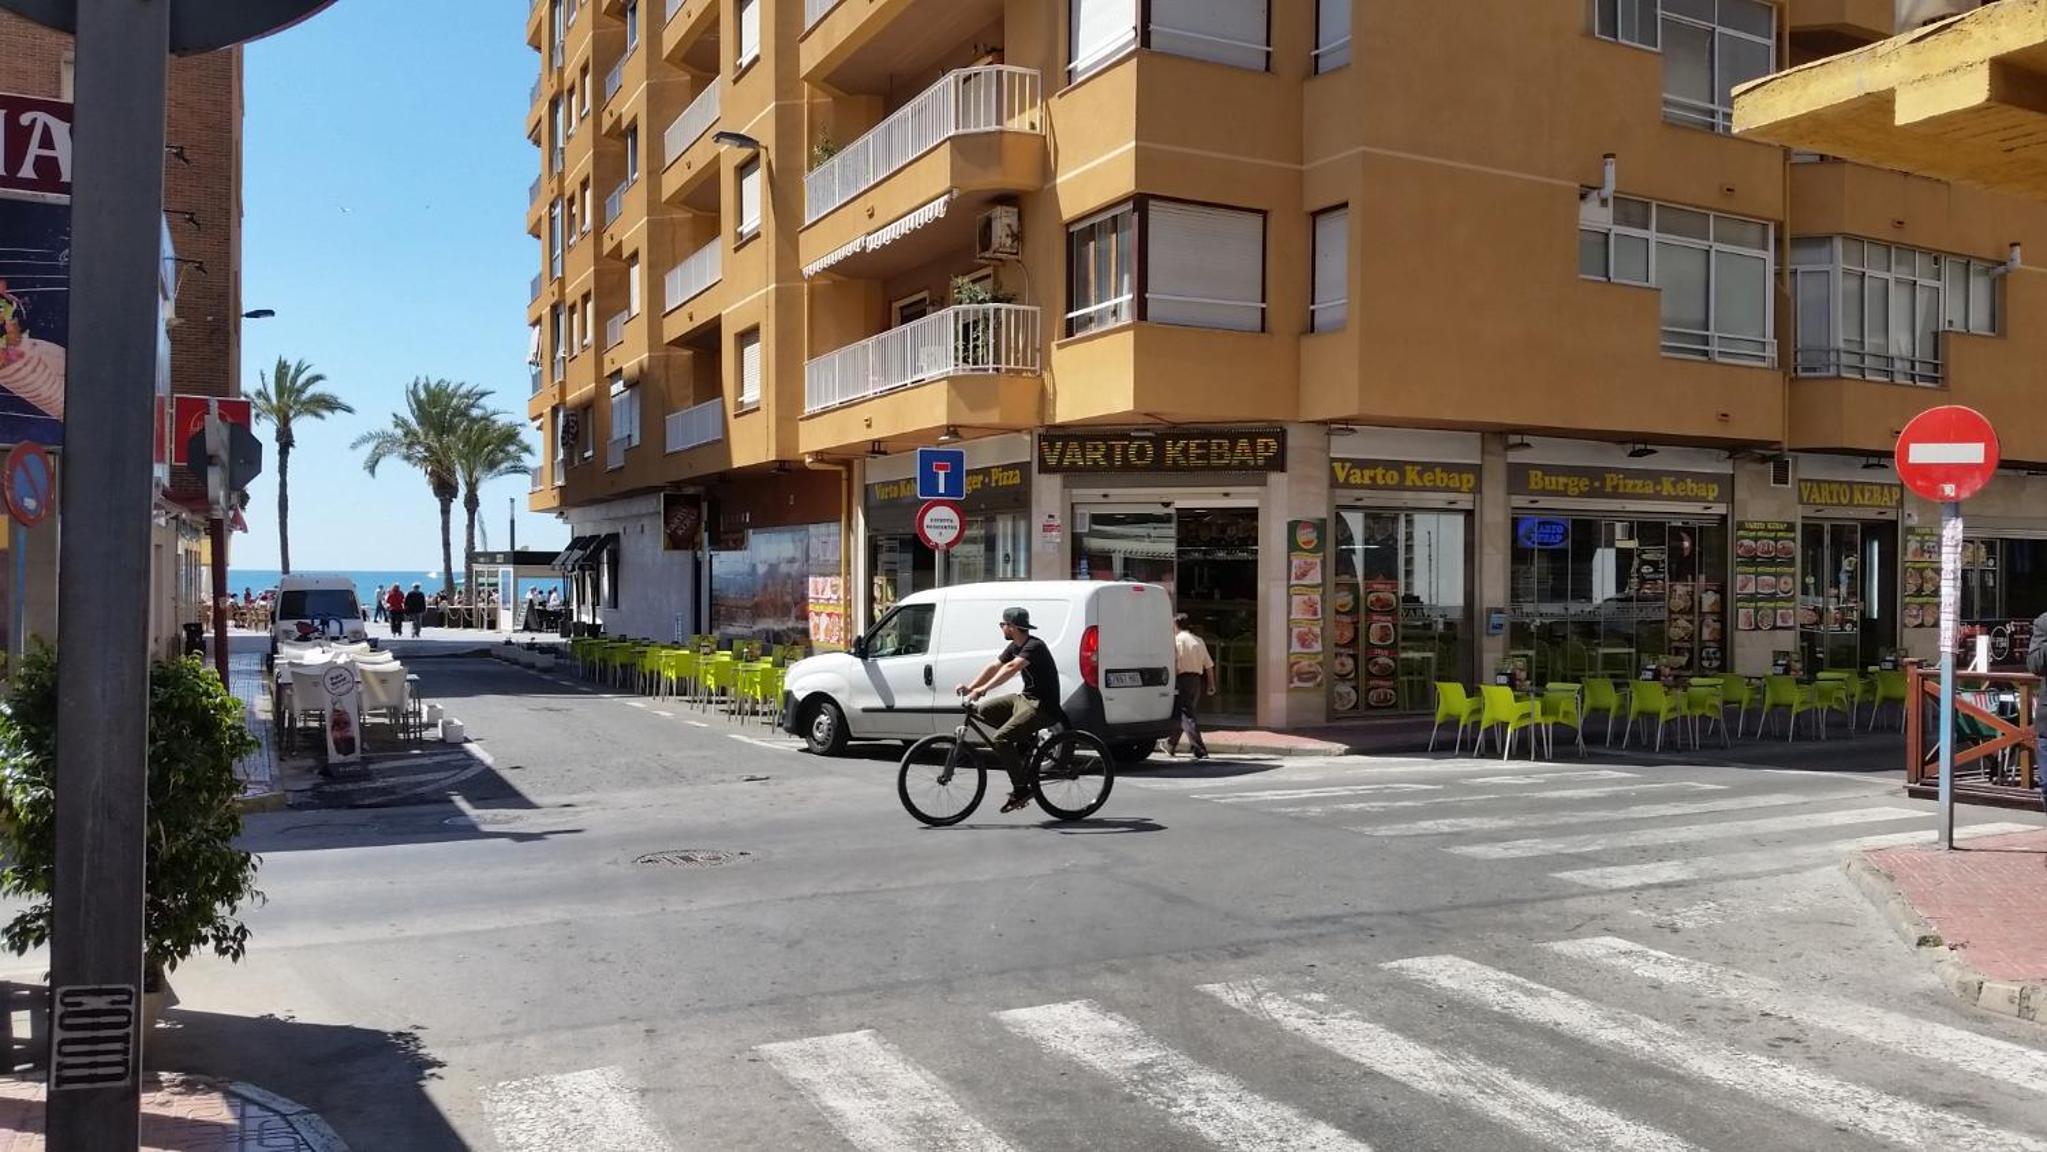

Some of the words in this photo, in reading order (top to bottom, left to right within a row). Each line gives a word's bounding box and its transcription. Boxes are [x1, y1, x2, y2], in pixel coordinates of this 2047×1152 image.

[1041, 440, 1155, 466] VARTO
[1165, 438, 1278, 467] KEBAP
[875, 481, 899, 501] Varto
[966, 473, 984, 494] ger
[991, 467, 1020, 487] Pizza
[1332, 462, 1399, 485] Varto
[1405, 465, 1475, 492] Kebap
[1528, 470, 1589, 495] Burge
[1604, 474, 1654, 494] Pizza
[1661, 477, 1719, 500] Kebap
[1800, 481, 1849, 504] VARTO
[1852, 484, 1900, 507] KEBAP
